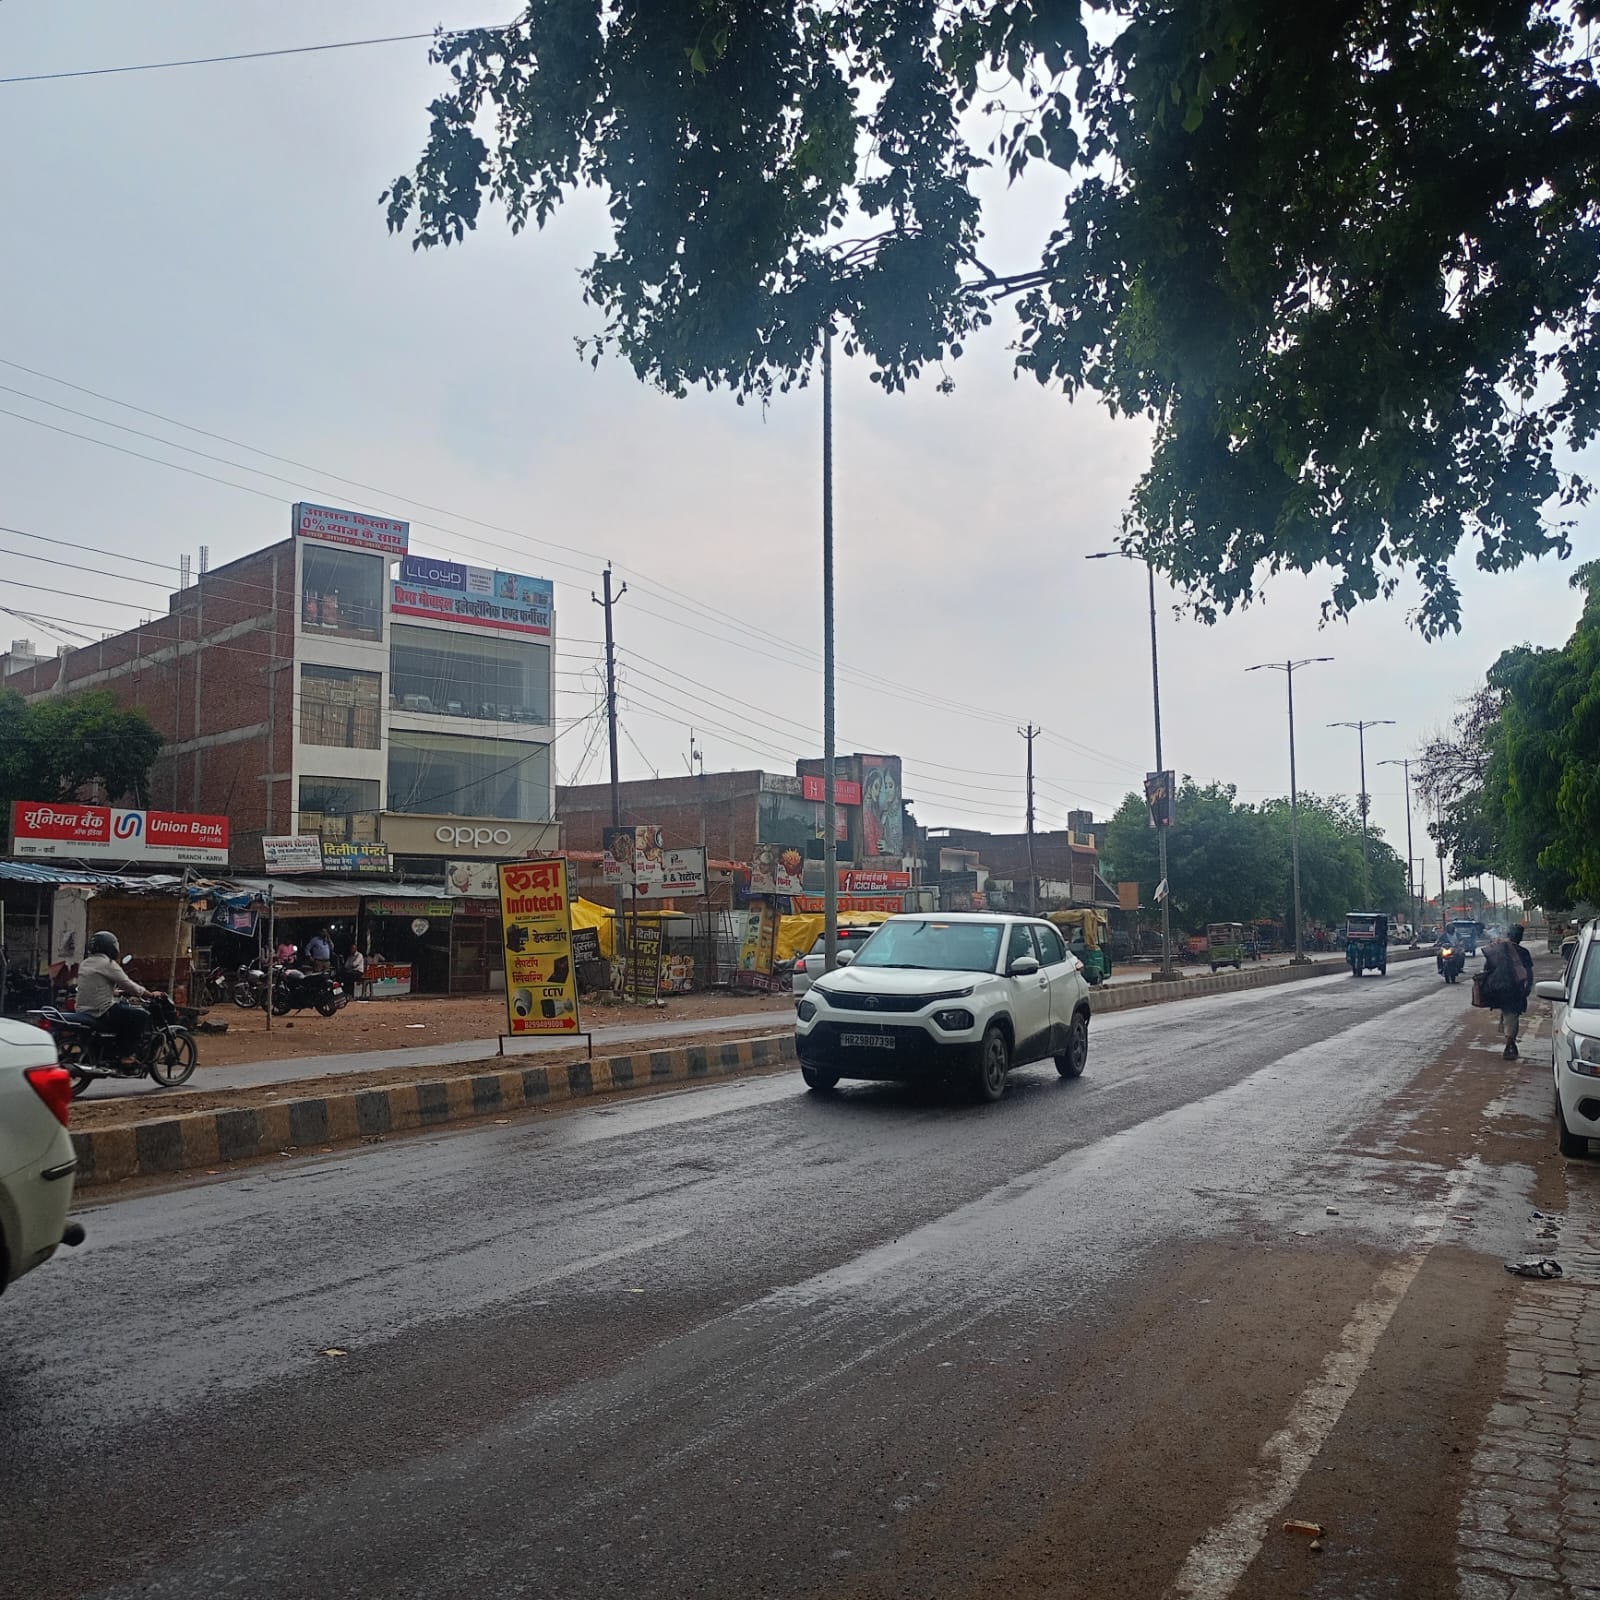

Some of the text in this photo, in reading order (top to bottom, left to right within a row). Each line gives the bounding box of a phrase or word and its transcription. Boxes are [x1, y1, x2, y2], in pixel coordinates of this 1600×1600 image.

[305, 508, 349, 522] आसान
[302, 517, 325, 532] 0%
[362, 528, 374, 538] के
[378, 532, 402, 544] साथ
[406, 564, 462, 584] LLOYD
[418, 589, 454, 611] मोबाइल
[24, 808, 104, 829] यूनियन बैंक
[151, 819, 222, 836] Union Bank
[324, 842, 359, 856] दिलीप
[360, 843, 386, 856] पेन्टर
[854, 882, 870, 890] ICICI
[870, 882, 888, 890] Bank
[506, 893, 562, 914] Infotech
[532, 928, 567, 942] डेस्कटॉप
[543, 988, 564, 997] CCTV
